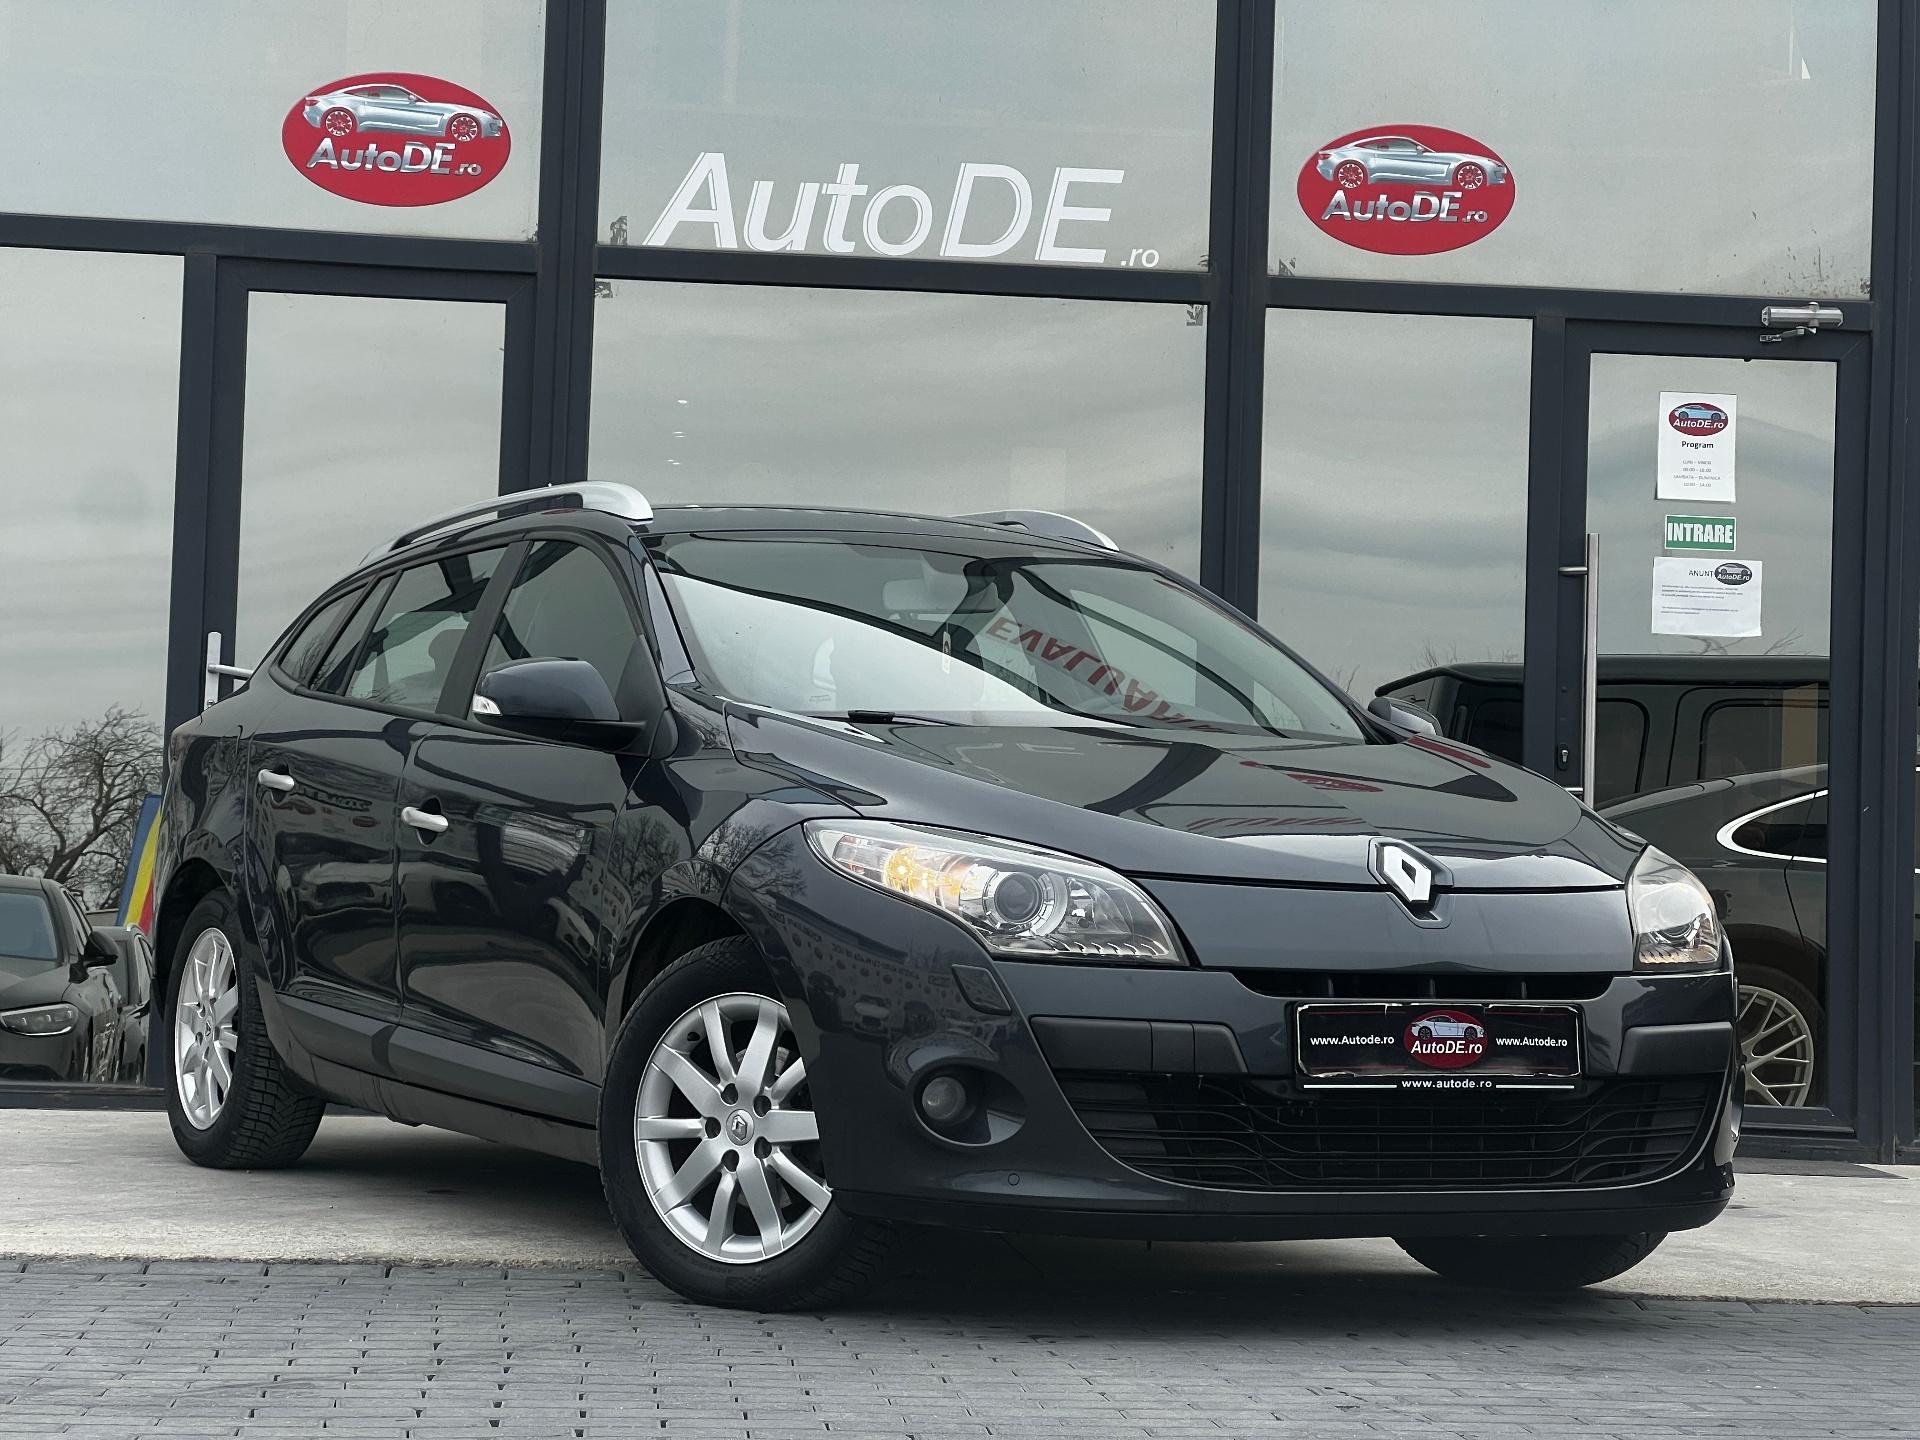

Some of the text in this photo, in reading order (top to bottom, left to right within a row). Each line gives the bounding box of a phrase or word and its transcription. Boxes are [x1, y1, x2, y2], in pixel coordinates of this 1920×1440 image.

[1673, 419, 1724, 429] AutoDE.ro
[1681, 440, 1714, 449] Program
[1667, 522, 1733, 543] INTRARE
[1310, 1034, 1395, 1045] www.Autode.ro
[1495, 1036, 1568, 1047] www.Autode.ro
[1411, 1040, 1483, 1054] AutoDE.ro
[1401, 1078, 1492, 1088] www.autode.ro
